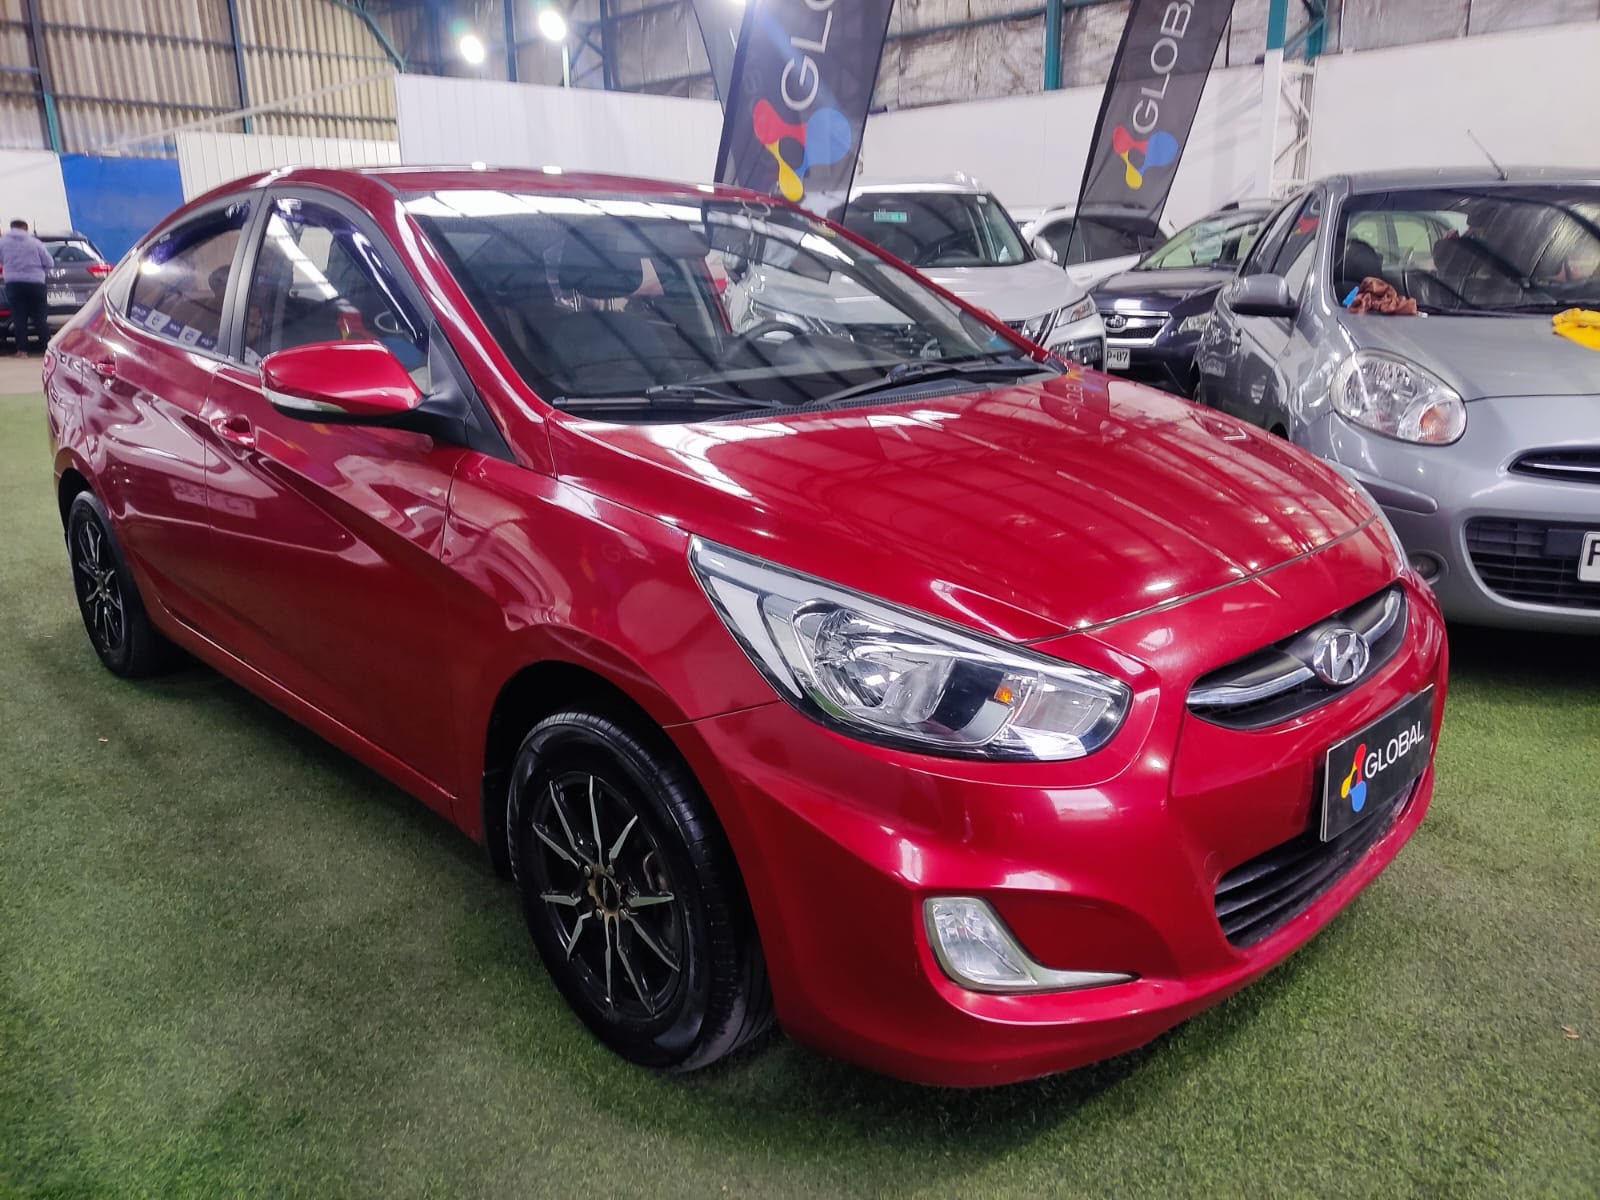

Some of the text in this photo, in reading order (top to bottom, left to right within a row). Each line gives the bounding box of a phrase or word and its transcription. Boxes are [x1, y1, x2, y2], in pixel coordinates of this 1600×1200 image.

[781, 0, 834, 112] GL
[1132, 0, 1195, 134] GLOB
[1364, 720, 1424, 778] GLOBAL
